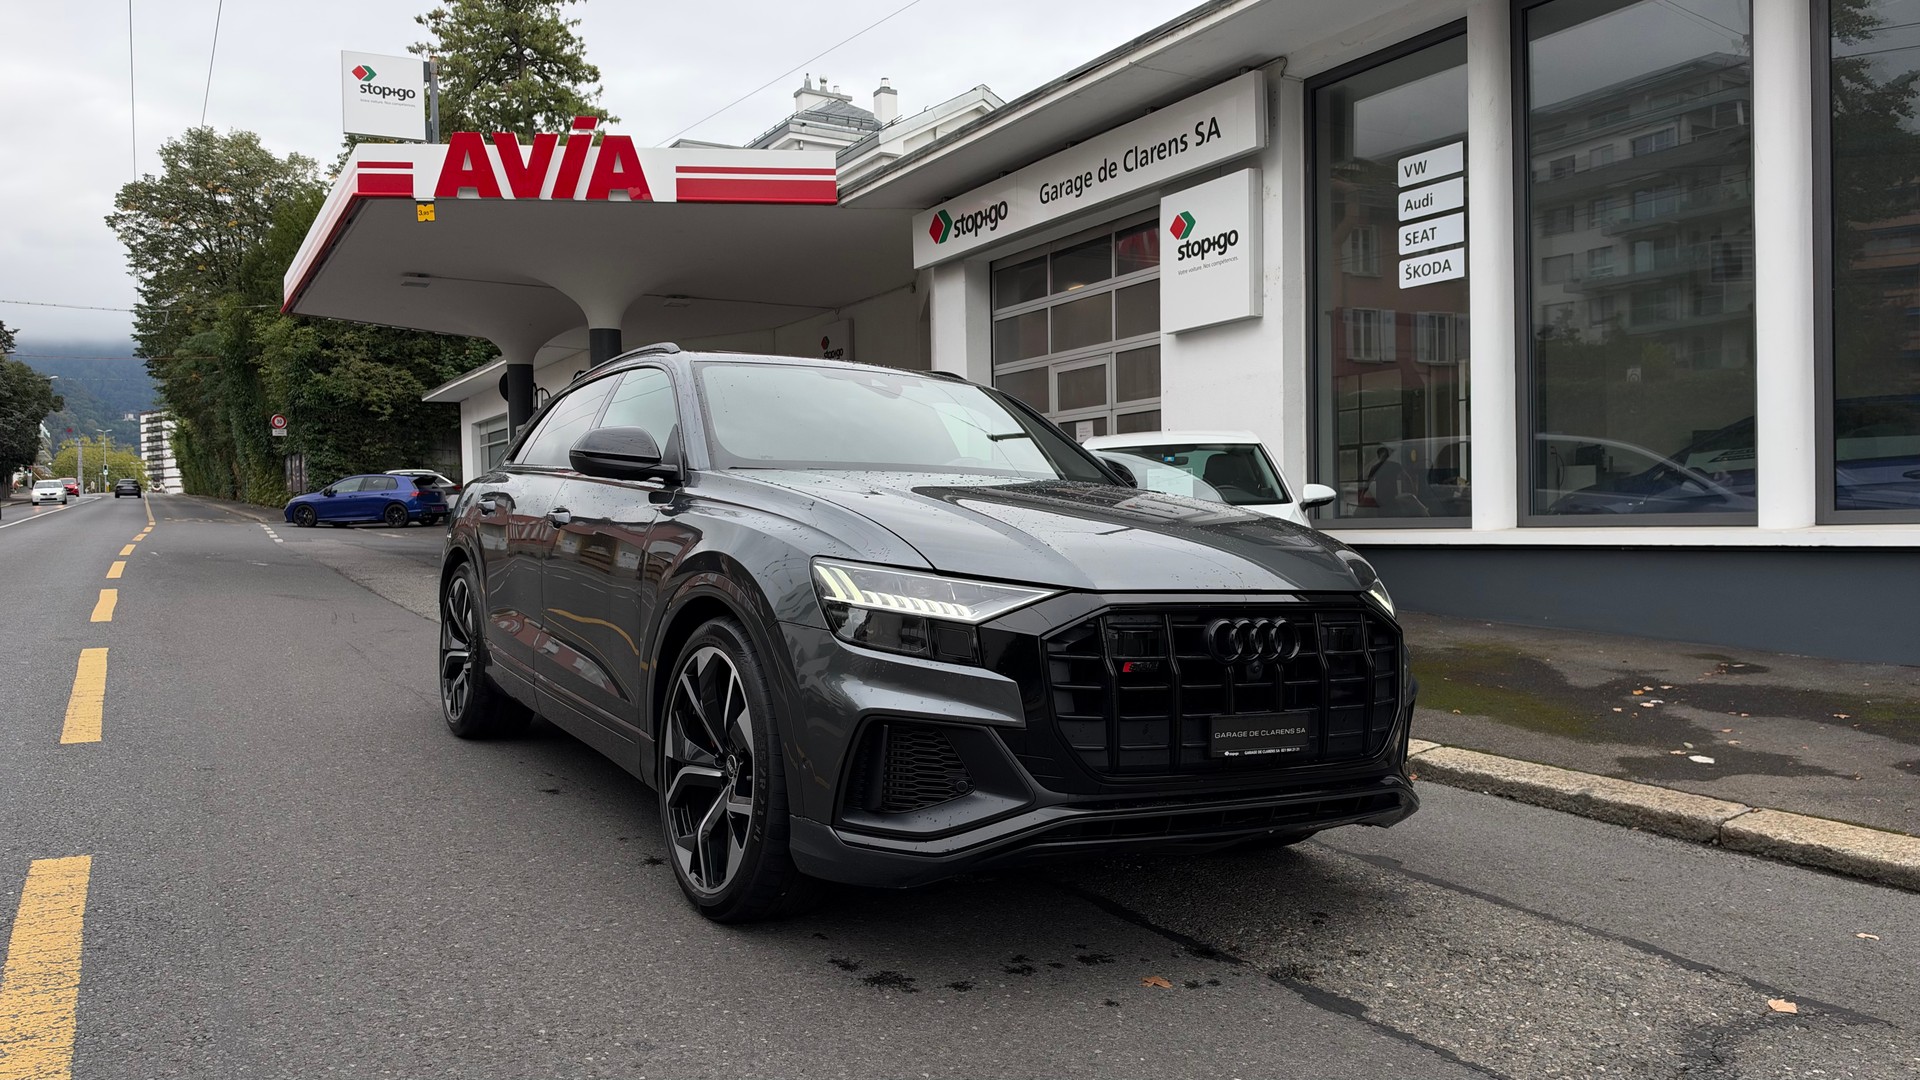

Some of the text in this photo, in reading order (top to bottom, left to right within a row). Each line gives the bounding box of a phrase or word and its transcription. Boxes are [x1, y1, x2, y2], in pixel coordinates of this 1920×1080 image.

[359, 82, 416, 101] stop+go
[433, 116, 654, 201] AVIA
[1039, 116, 1222, 204] Garage de Clarens SA
[1403, 159, 1428, 178] VW
[1404, 192, 1433, 213] Audi
[953, 200, 1009, 239] stop+go
[1177, 229, 1240, 261] stop+go
[1405, 226, 1438, 247] SEAT
[1405, 258, 1452, 281] ŠKODA
[1214, 731, 1248, 739] GARAGE
[1260, 728, 1295, 737] CLARENS
